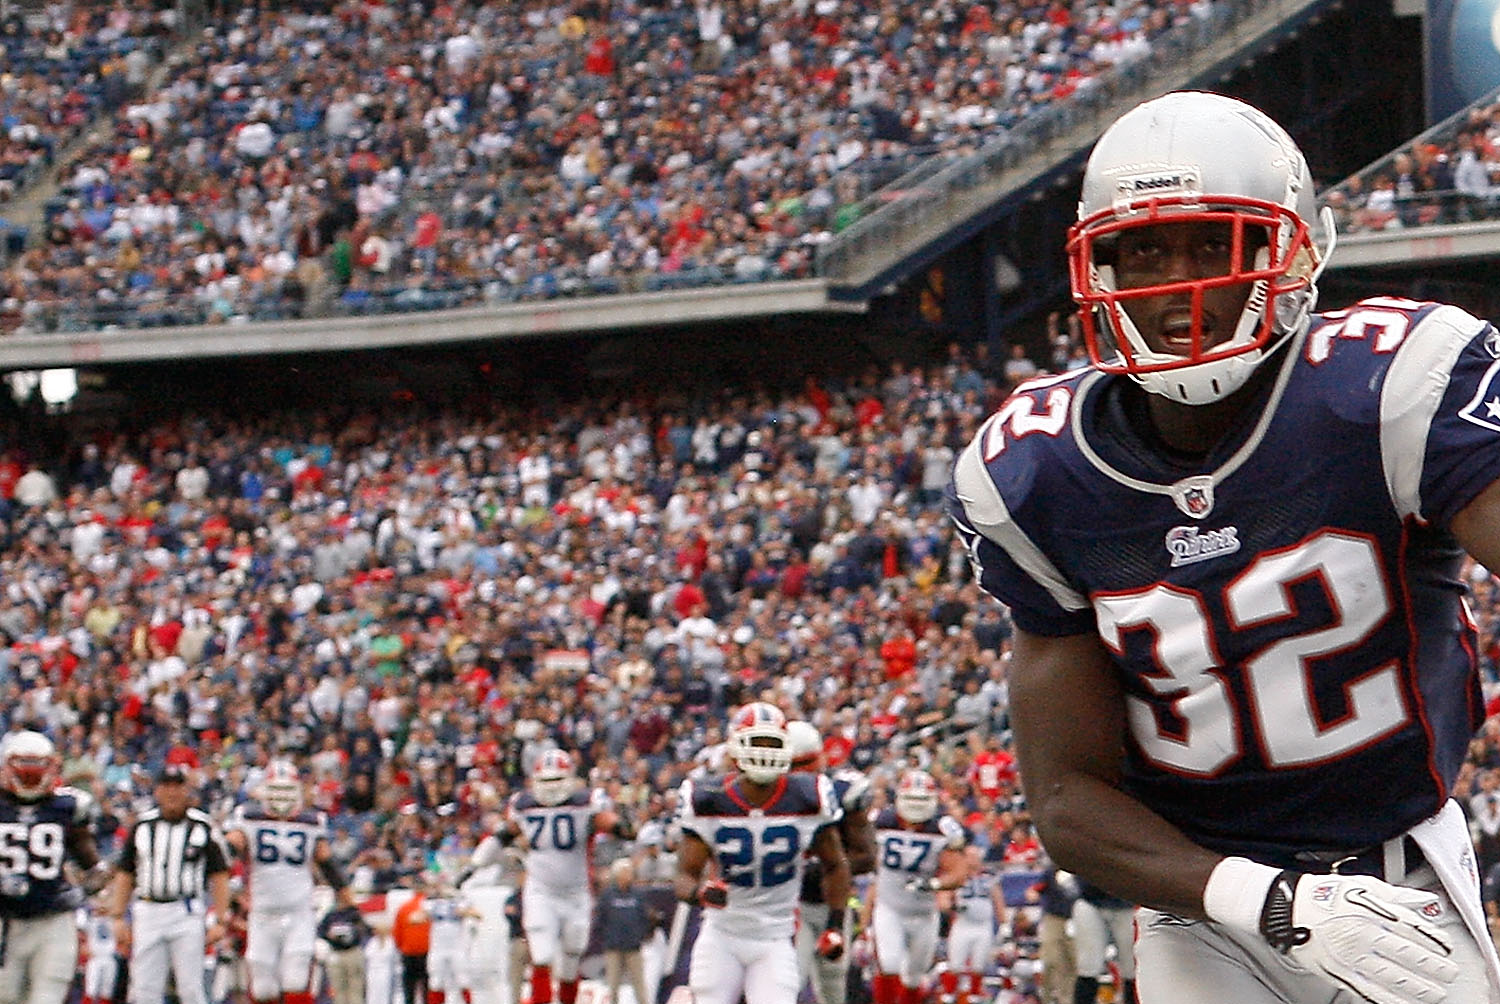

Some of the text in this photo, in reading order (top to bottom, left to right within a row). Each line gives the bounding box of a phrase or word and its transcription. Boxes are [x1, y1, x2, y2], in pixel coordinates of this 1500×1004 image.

[1134, 176, 1181, 192] Riddell
[1090, 527, 1413, 779] 32
[256, 828, 307, 865] 63
[525, 813, 576, 850] 70
[0, 822, 64, 880] 59
[714, 825, 799, 888] 22
[893, 837, 931, 872] 67
